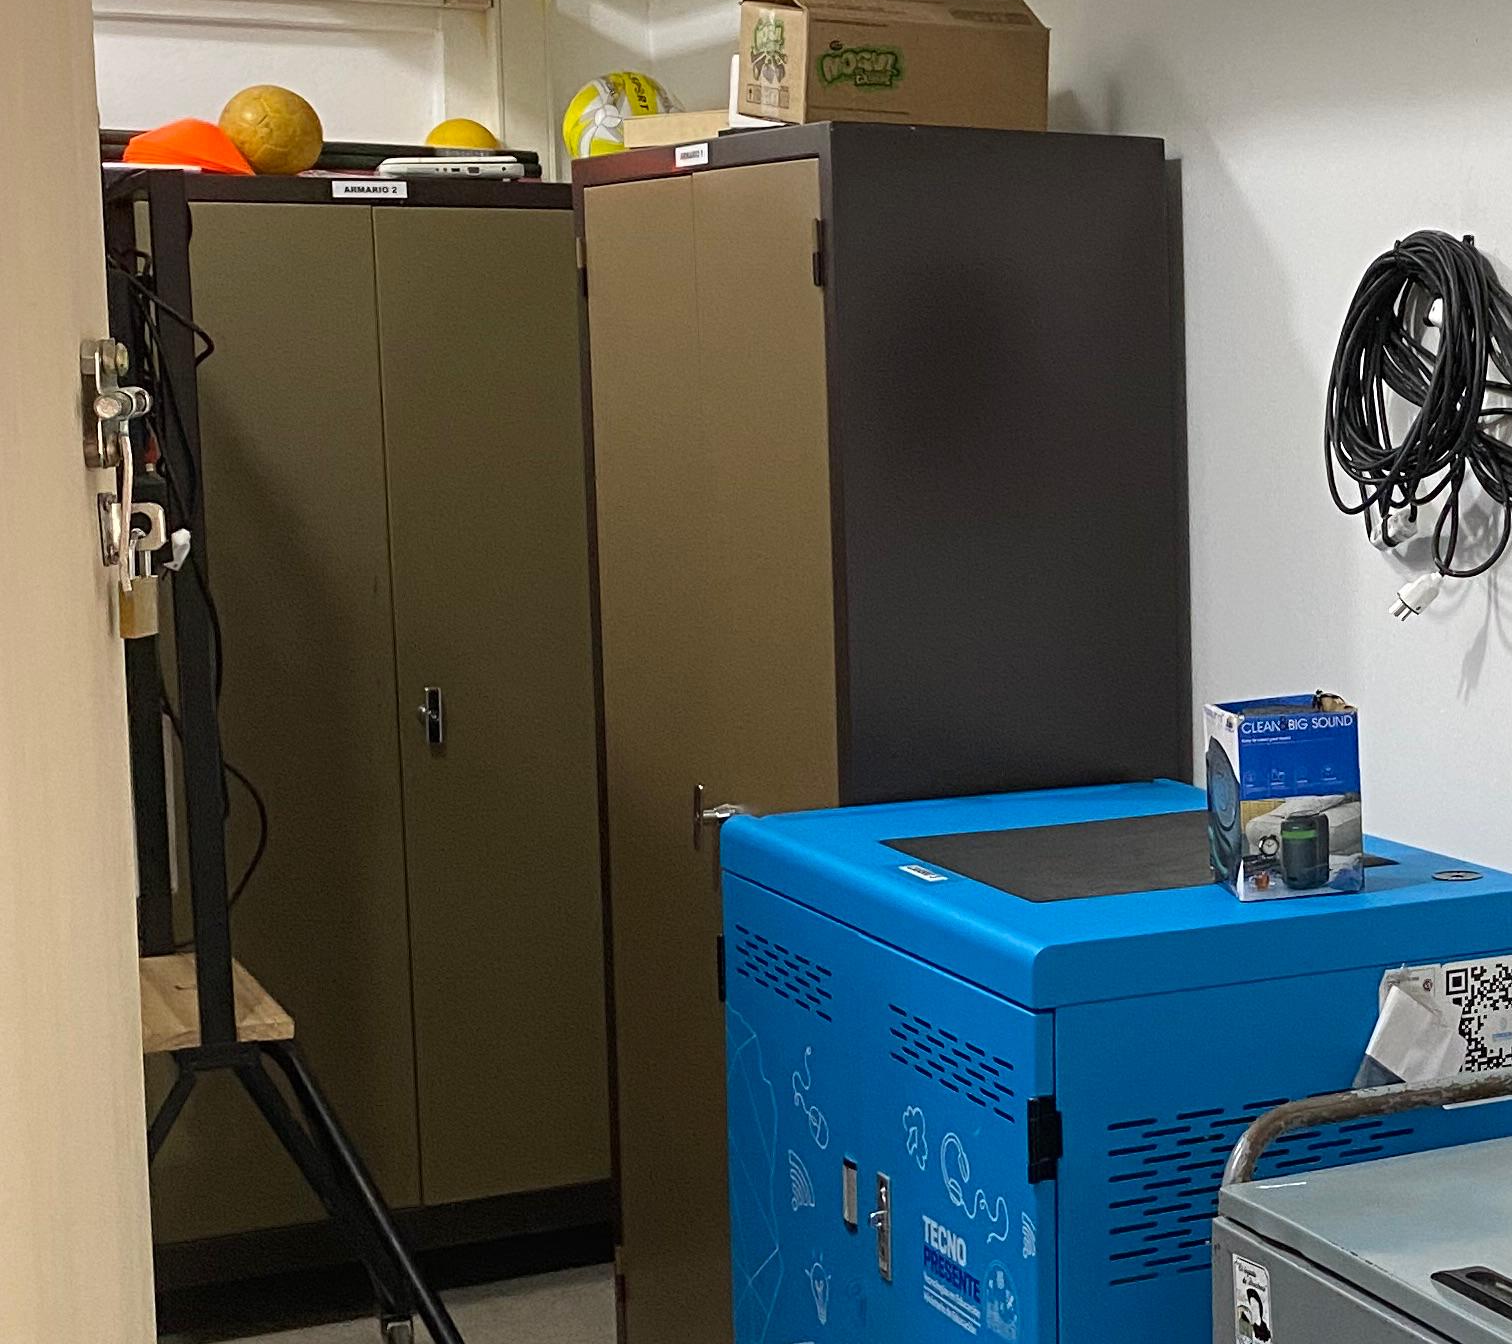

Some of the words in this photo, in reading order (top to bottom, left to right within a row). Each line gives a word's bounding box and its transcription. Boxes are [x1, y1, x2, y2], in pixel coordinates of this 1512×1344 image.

[392, 186, 397, 194] 2
[1241, 720, 1280, 734] CLEAN
[1288, 718, 1308, 731] BIG
[1311, 715, 1353, 729] SOUND
[922, 1215, 966, 1267] TECNO
[924, 1244, 981, 1304] PRESENTE
